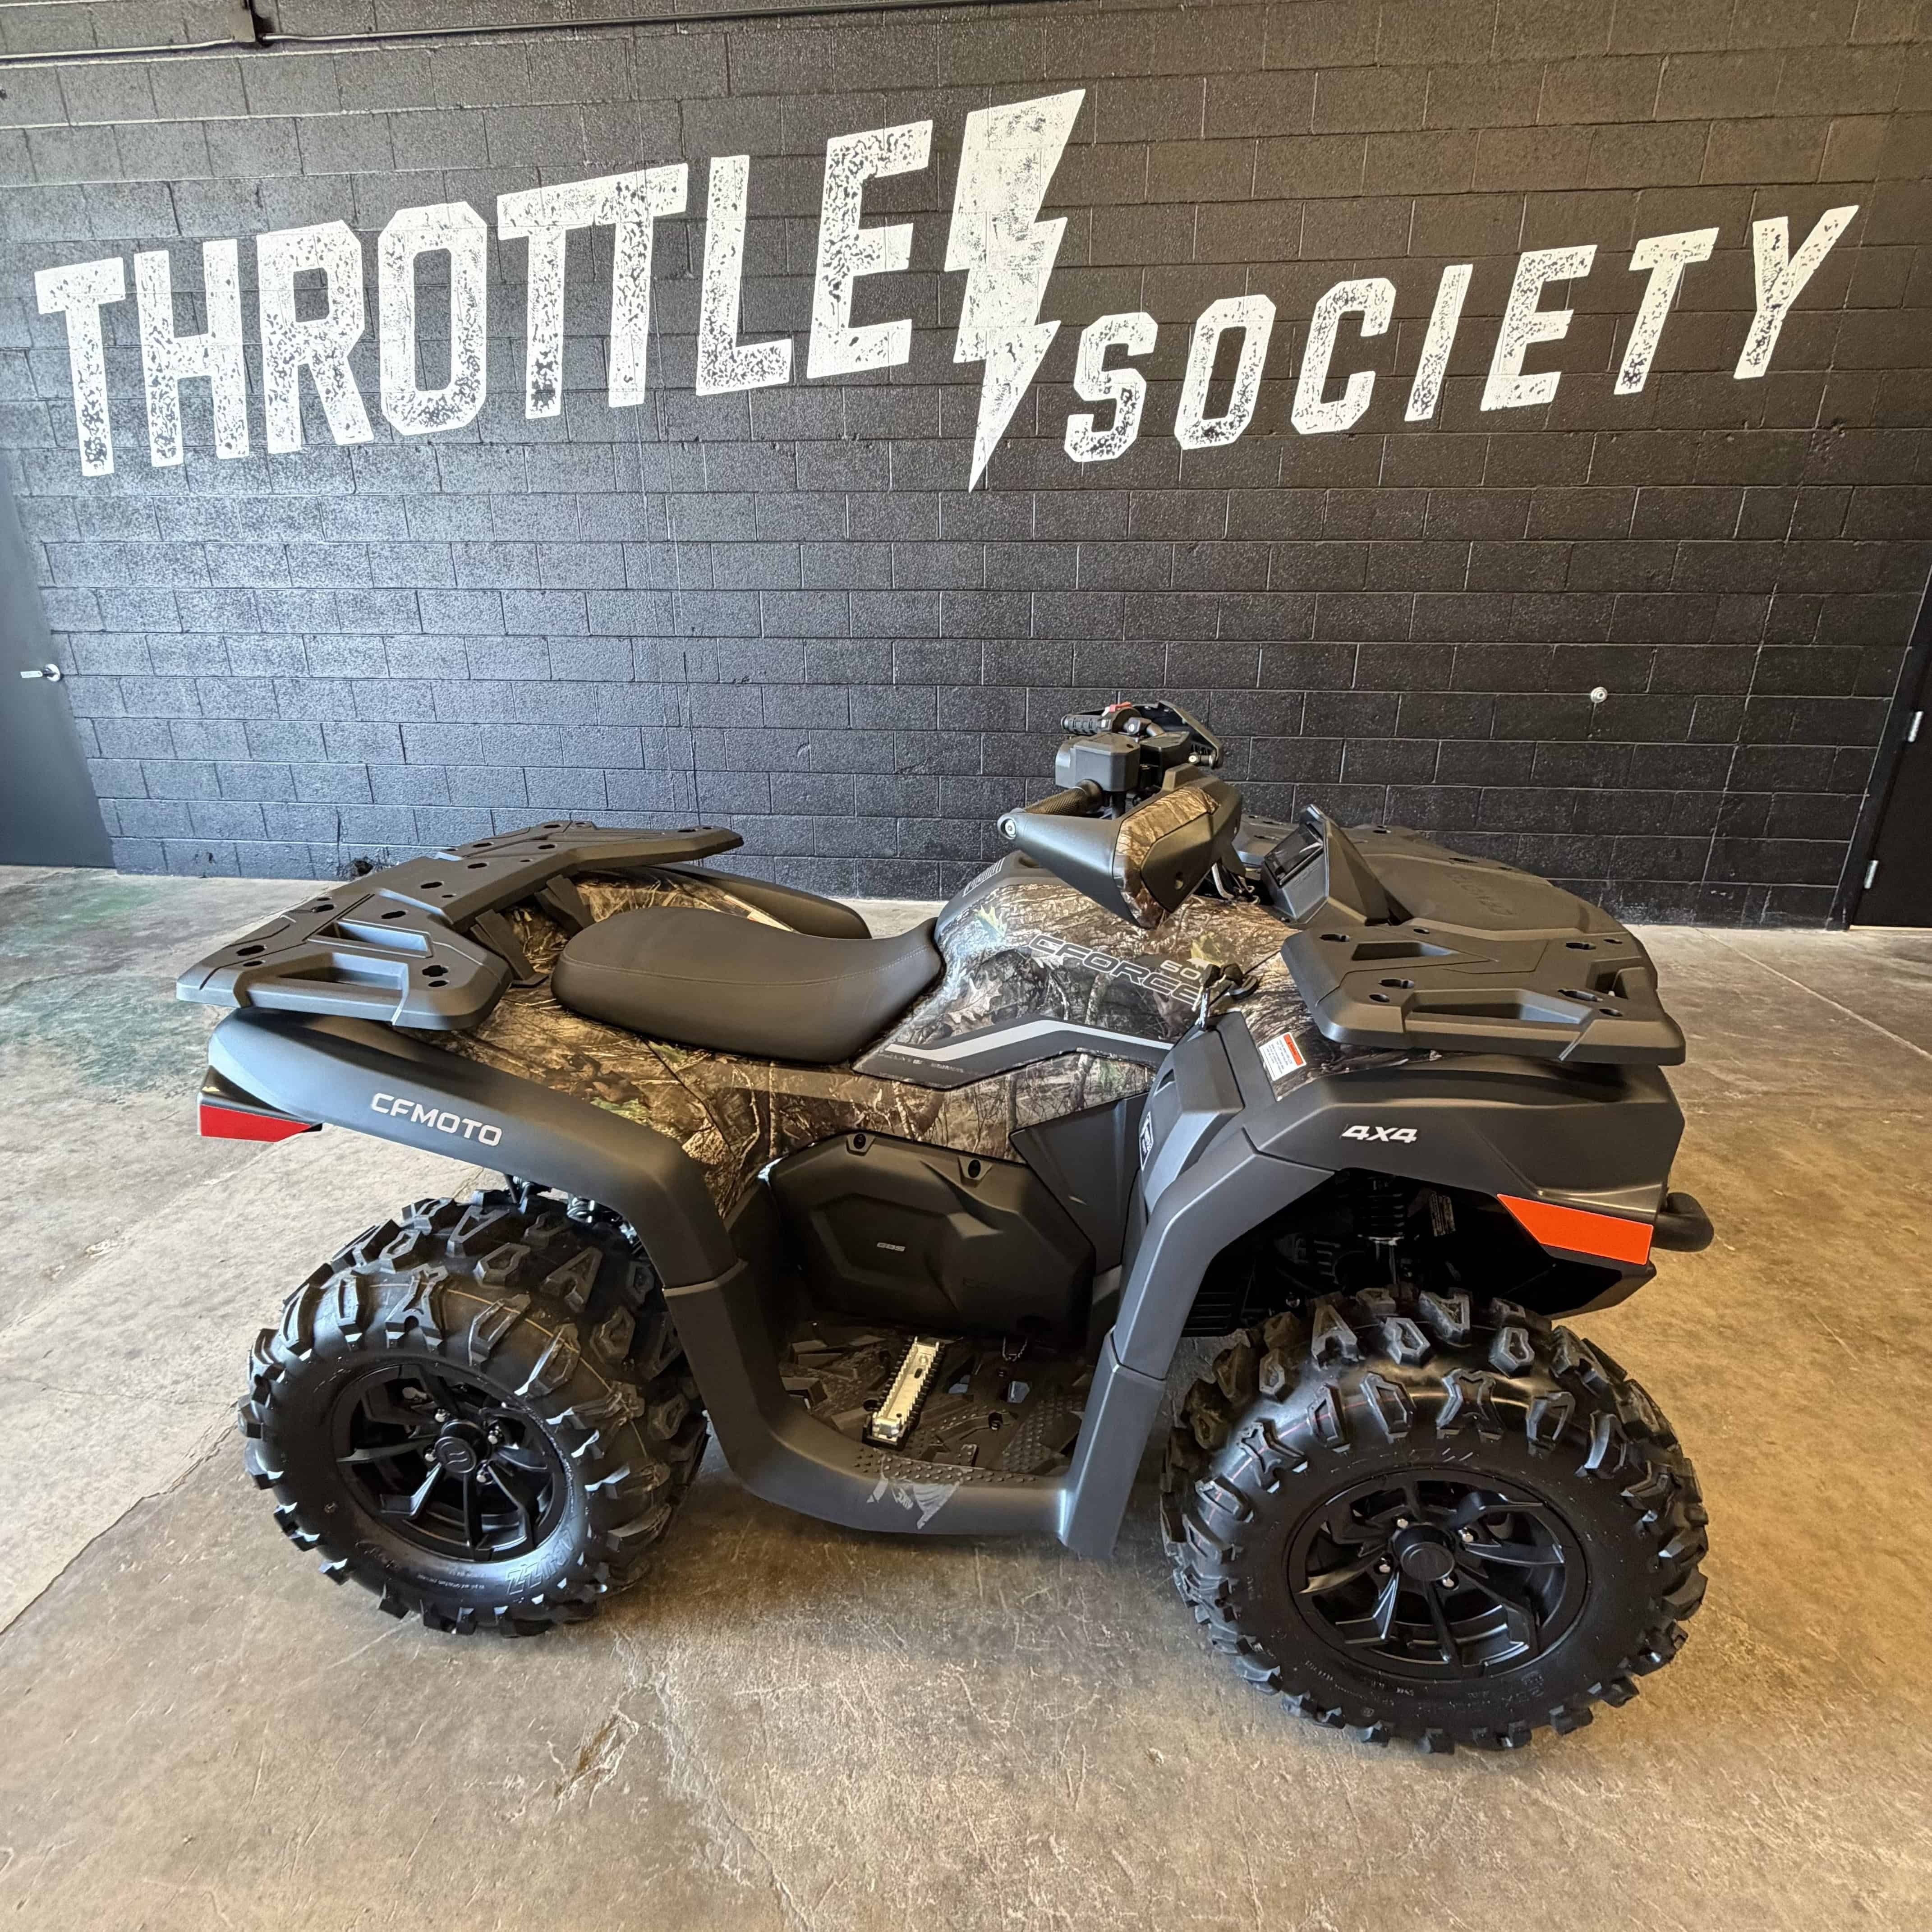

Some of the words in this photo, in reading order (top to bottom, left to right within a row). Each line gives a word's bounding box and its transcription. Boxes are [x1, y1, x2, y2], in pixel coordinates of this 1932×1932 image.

[34, 120, 933, 477] THROTTLE
[1063, 205, 1860, 463] SOCIETY
[1029, 934, 1201, 1007] CFORCE
[371, 1093, 502, 1146] CFMOTO
